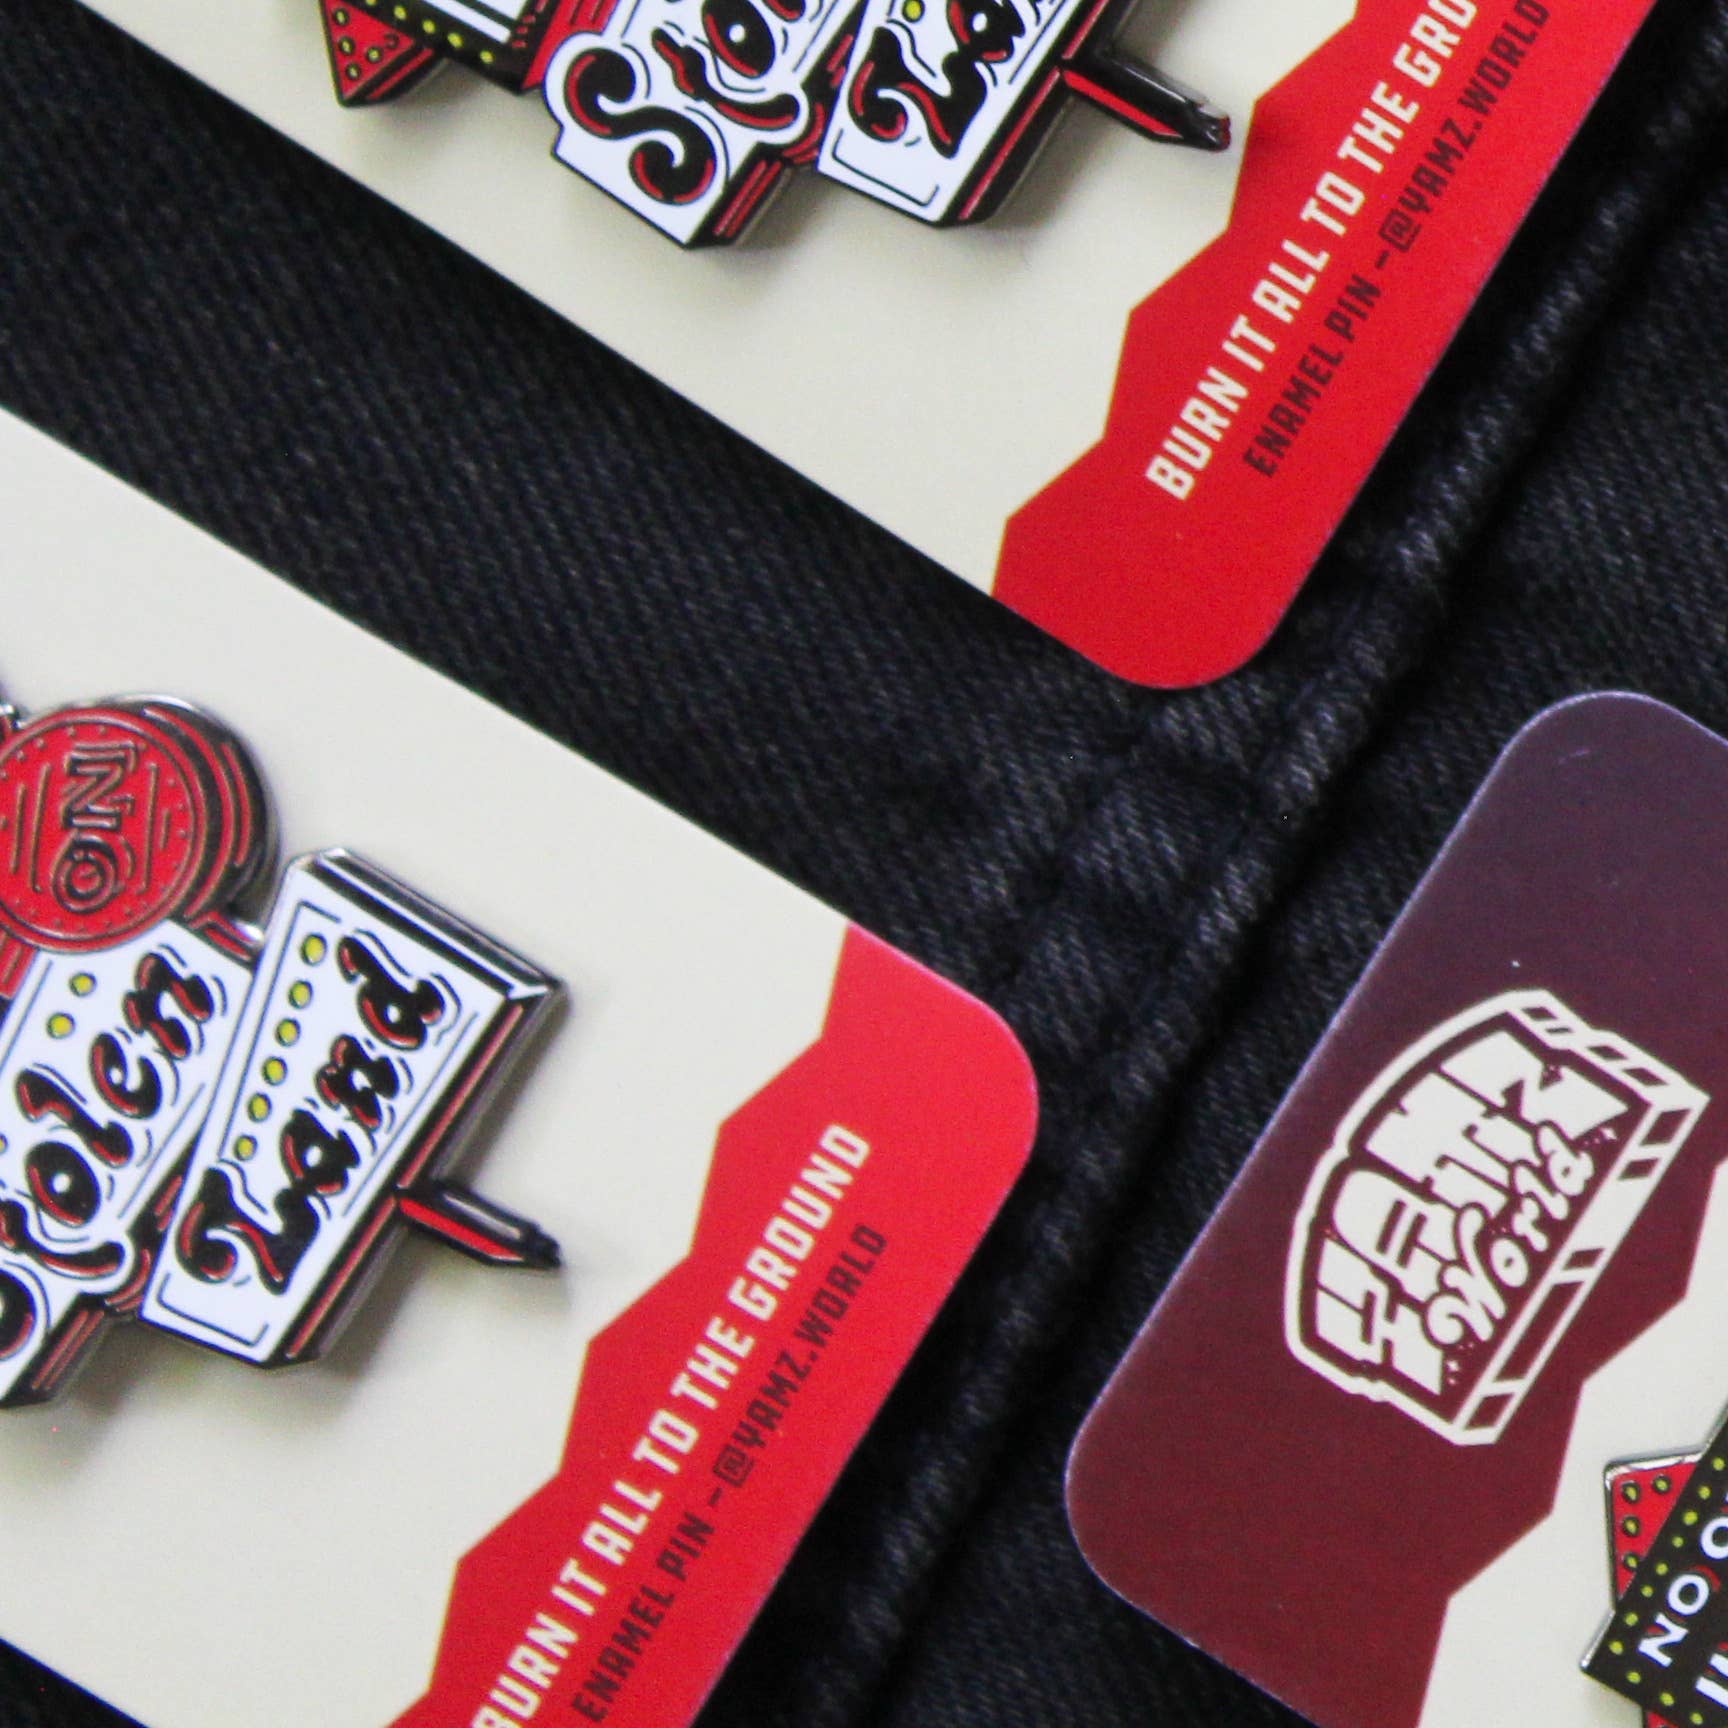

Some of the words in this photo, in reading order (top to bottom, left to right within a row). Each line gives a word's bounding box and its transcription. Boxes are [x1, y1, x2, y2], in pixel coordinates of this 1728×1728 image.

[1145, 367, 1247, 500] BURN
[1223, 315, 1274, 370] IT
[1254, 240, 1329, 321] ALL
[1301, 171, 1365, 234] TO
[1338, 82, 1418, 171] THE
[1243, 345, 1343, 476] ENAMEL
[1325, 275, 1381, 340] PIN
[53, 757, 126, 915] ON
[0, 951, 215, 1361] tolen
[175, 936, 446, 1295] Land
[1427, 1124, 1594, 1342] World
[552, 1559, 605, 1614] IT
[584, 1481, 661, 1564] ALL
[633, 1410, 698, 1473] TO
[672, 1317, 754, 1408] THE
[730, 1125, 868, 1319] GROUND
[572, 1586, 674, 1721] ENAMEL
[656, 1513, 713, 1579] PIN
[1638, 1572, 1710, 1667] NO
